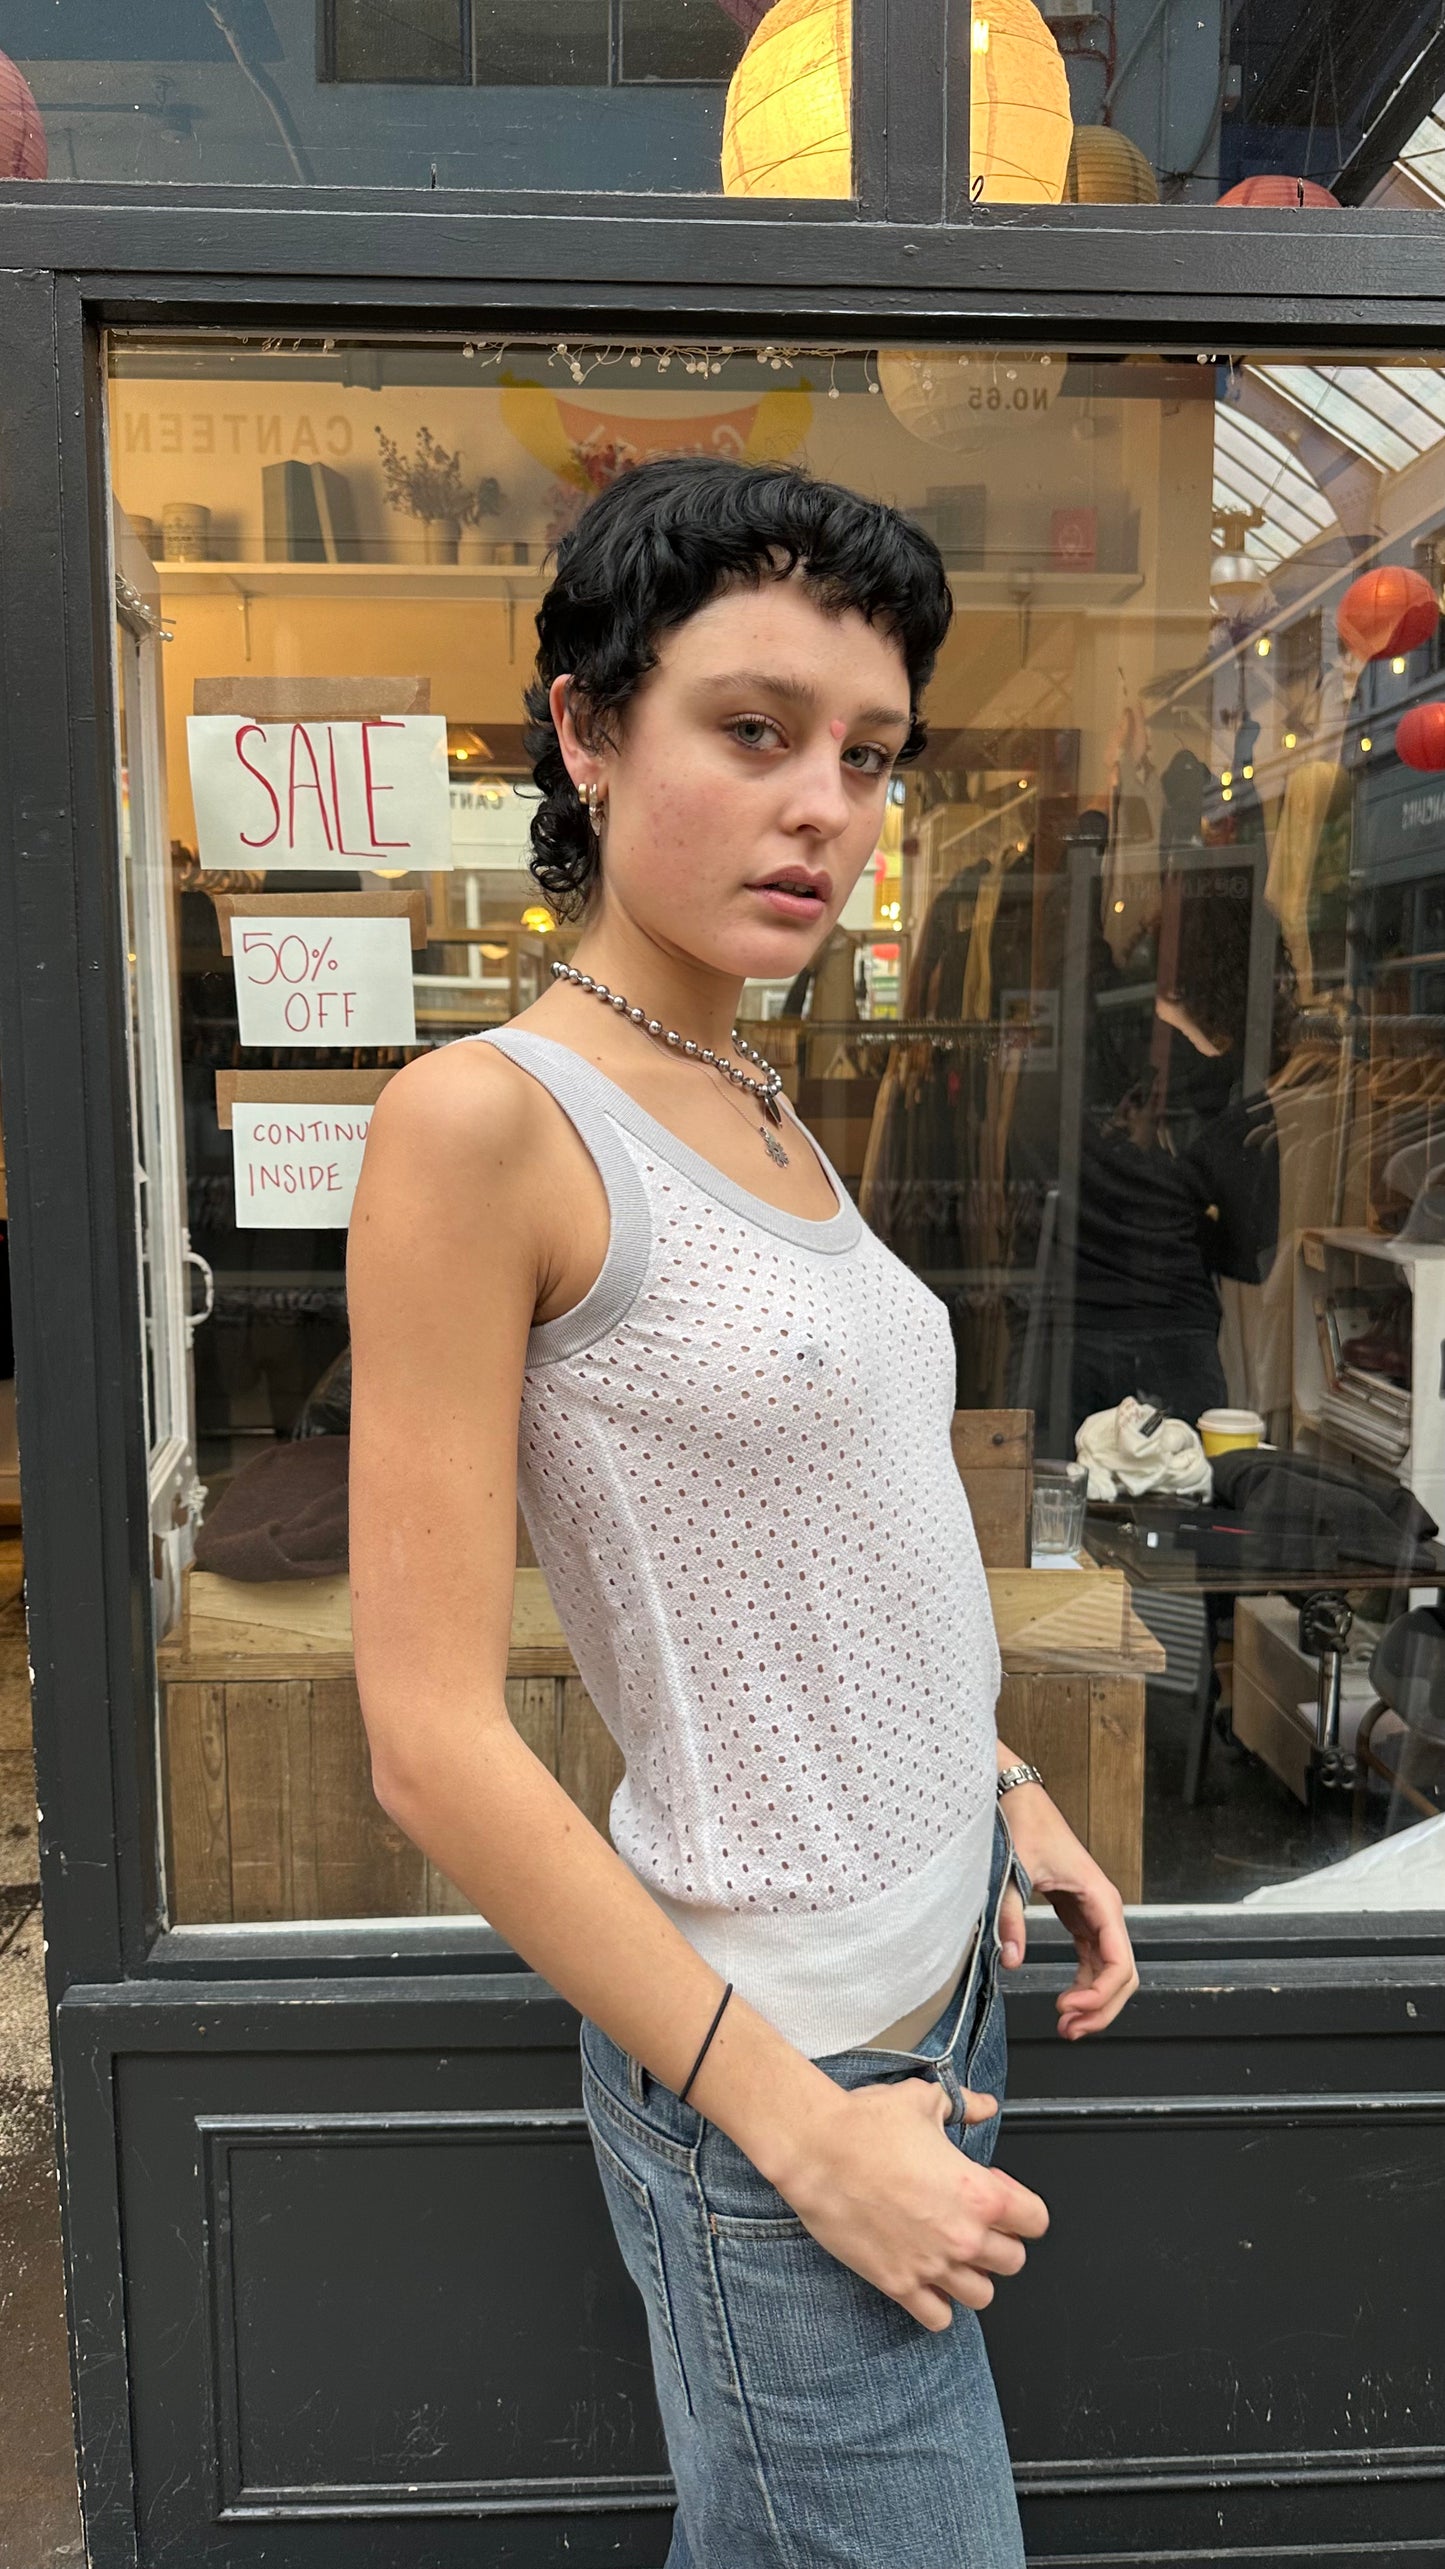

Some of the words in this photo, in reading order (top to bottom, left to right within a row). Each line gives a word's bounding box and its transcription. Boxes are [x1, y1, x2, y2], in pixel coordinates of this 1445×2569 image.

[235, 721, 411, 858] SALE
[242, 932, 338, 985] 50%
[284, 992, 357, 1032] OFF
[248, 1162, 343, 1197] INSIDE
